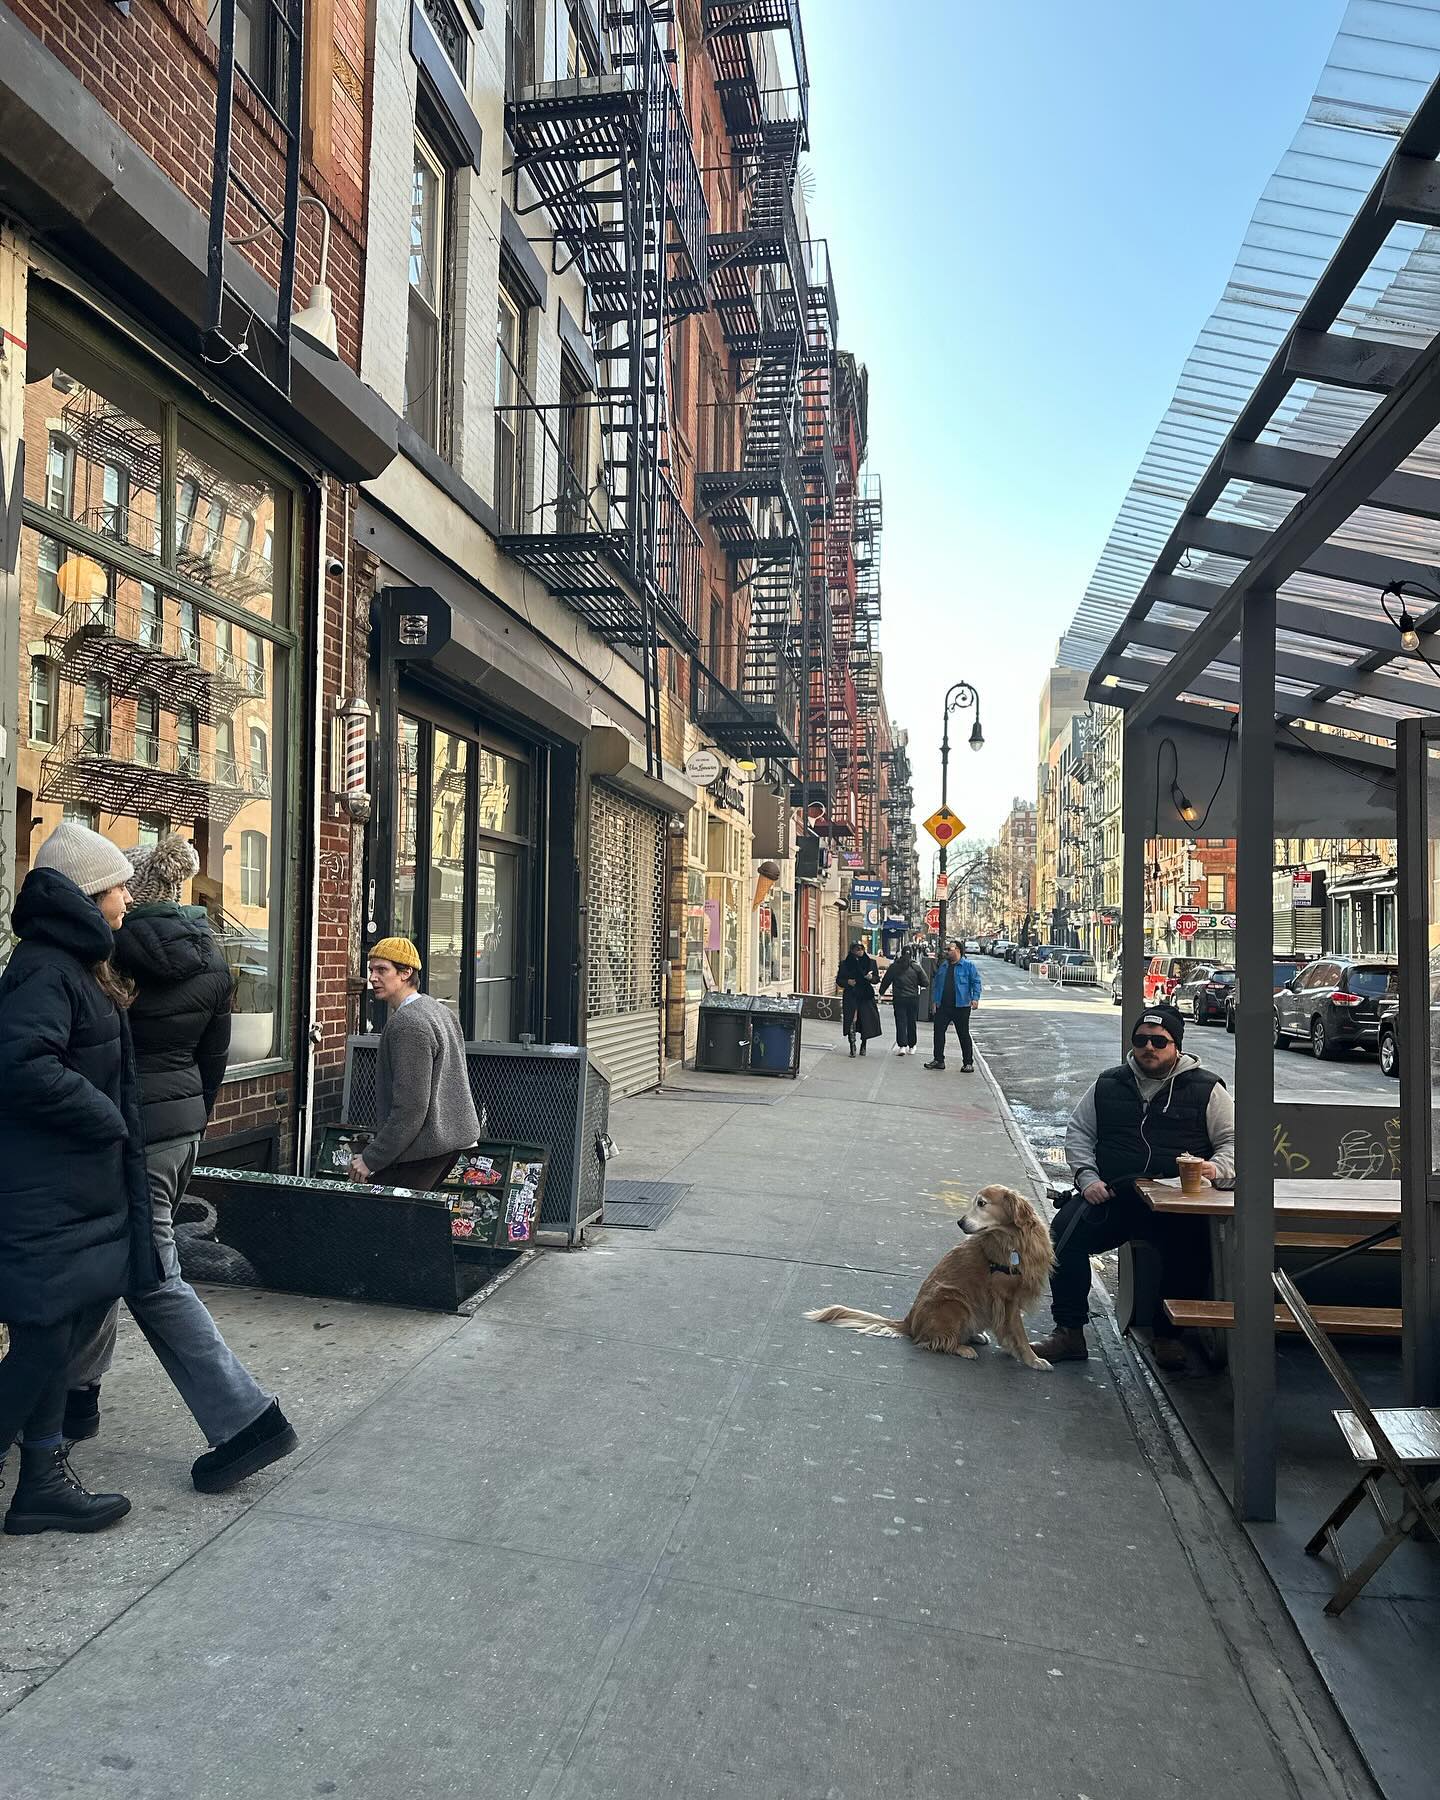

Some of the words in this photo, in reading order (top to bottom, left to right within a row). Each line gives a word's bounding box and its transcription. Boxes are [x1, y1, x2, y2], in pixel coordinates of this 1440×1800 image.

[777, 806, 785, 821] New
[777, 821, 786, 854] Assembly
[1177, 920, 1197, 930] STOP
